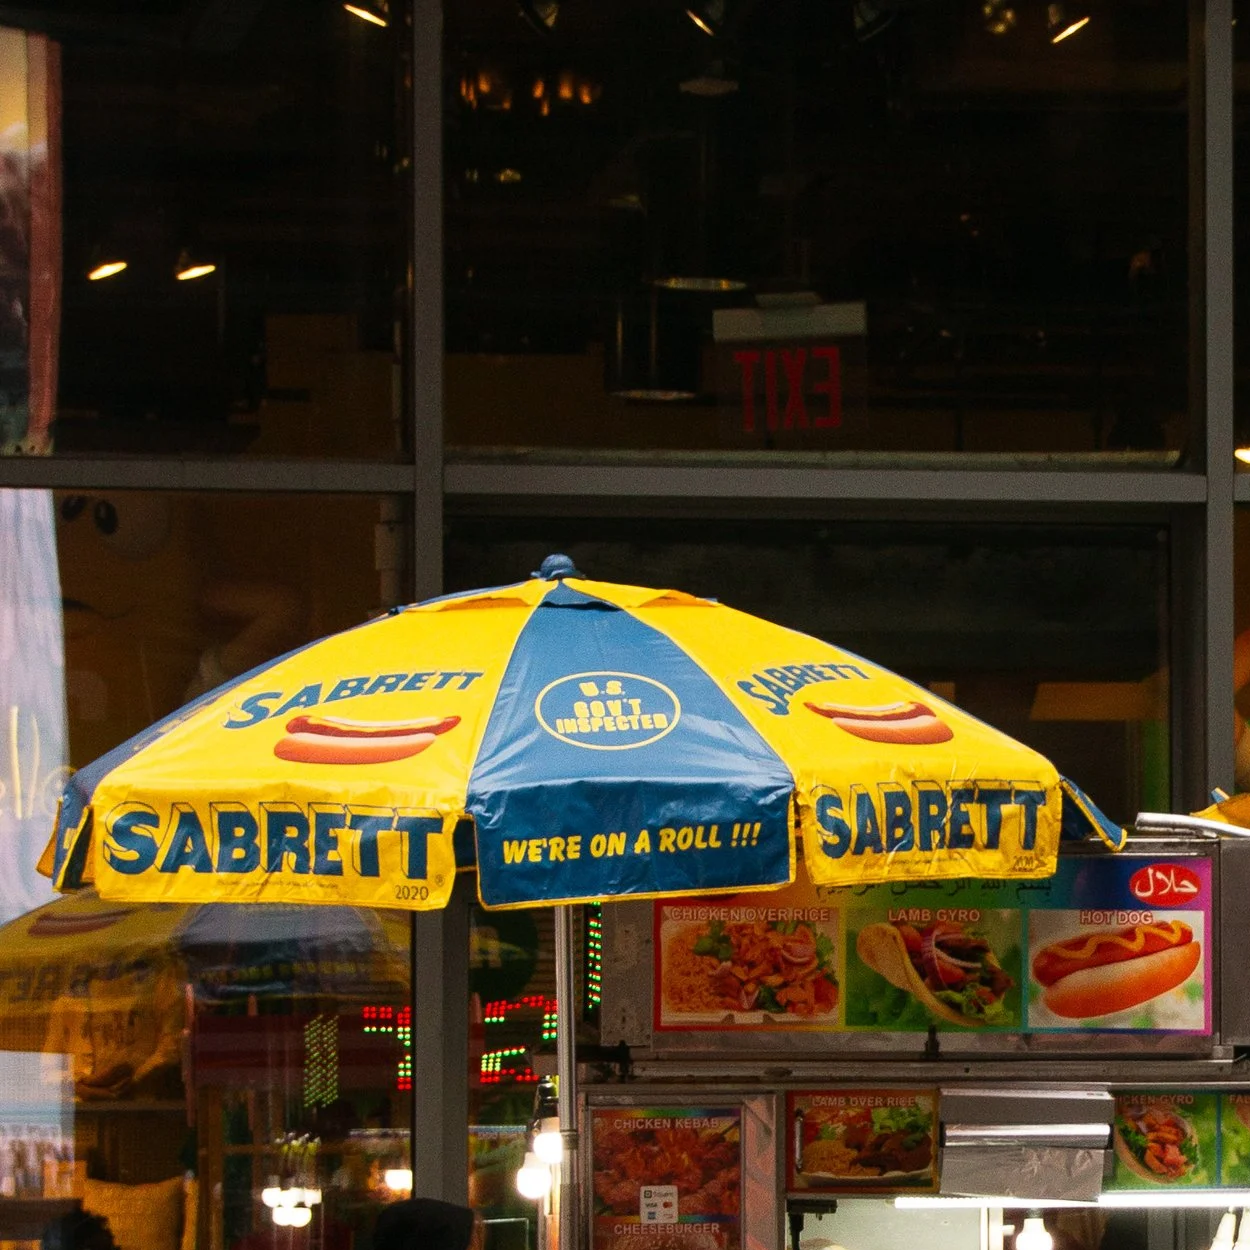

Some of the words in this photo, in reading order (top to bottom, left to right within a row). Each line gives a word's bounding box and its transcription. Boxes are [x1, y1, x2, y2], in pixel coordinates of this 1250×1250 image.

[578, 682, 625, 698] U.S.
[736, 662, 873, 717] SABRETT
[224, 670, 485, 730] SABRETT
[573, 697, 642, 718] GOV'T
[555, 712, 669, 735] INSPECTED
[809, 779, 1050, 861] SABRETT
[103, 800, 444, 880] SABRETT
[503, 835, 581, 864] WE'RE
[589, 831, 625, 855] ON
[633, 833, 652, 853] A
[657, 824, 722, 851] ROLL
[1133, 869, 1199, 898] حلال
[394, 885, 430, 901] 2020
[670, 906, 743, 923] CHICKEN
[745, 906, 790, 923] OVER
[792, 907, 830, 923] RICE
[887, 908, 933, 924] LAMB
[934, 907, 981, 924] GYRO
[1079, 909, 1113, 925] HOT
[1116, 909, 1154, 926] DOG
[812, 1095, 847, 1107] LAMB
[850, 1095, 884, 1107] OVER
[887, 1095, 916, 1107] RICE
[1115, 1094, 1156, 1105] HICKEN
[1159, 1094, 1194, 1105] GYRO
[614, 1118, 671, 1130] CHICKEN
[674, 1118, 719, 1130] KEBAB
[613, 1223, 720, 1235] CHEESEBURGER
